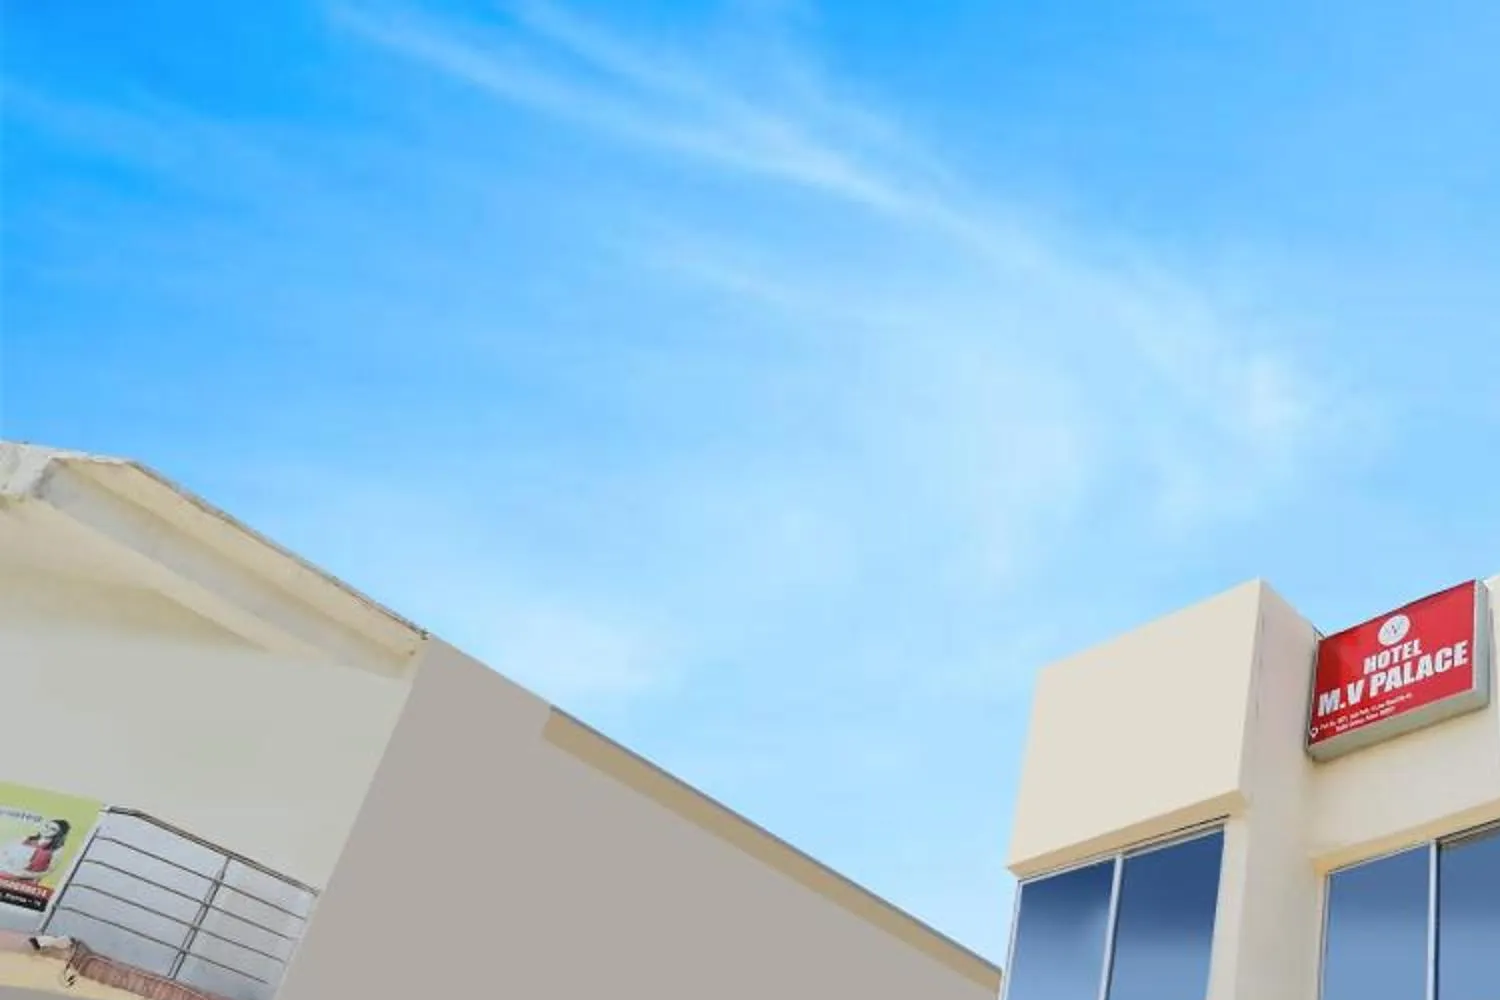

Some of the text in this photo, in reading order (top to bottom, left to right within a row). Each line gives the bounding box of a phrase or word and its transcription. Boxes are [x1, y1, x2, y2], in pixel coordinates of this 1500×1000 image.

[1318, 679, 1364, 717] M.V
[1370, 640, 1468, 696] PALACE
[1364, 639, 1422, 674] HOTEL
